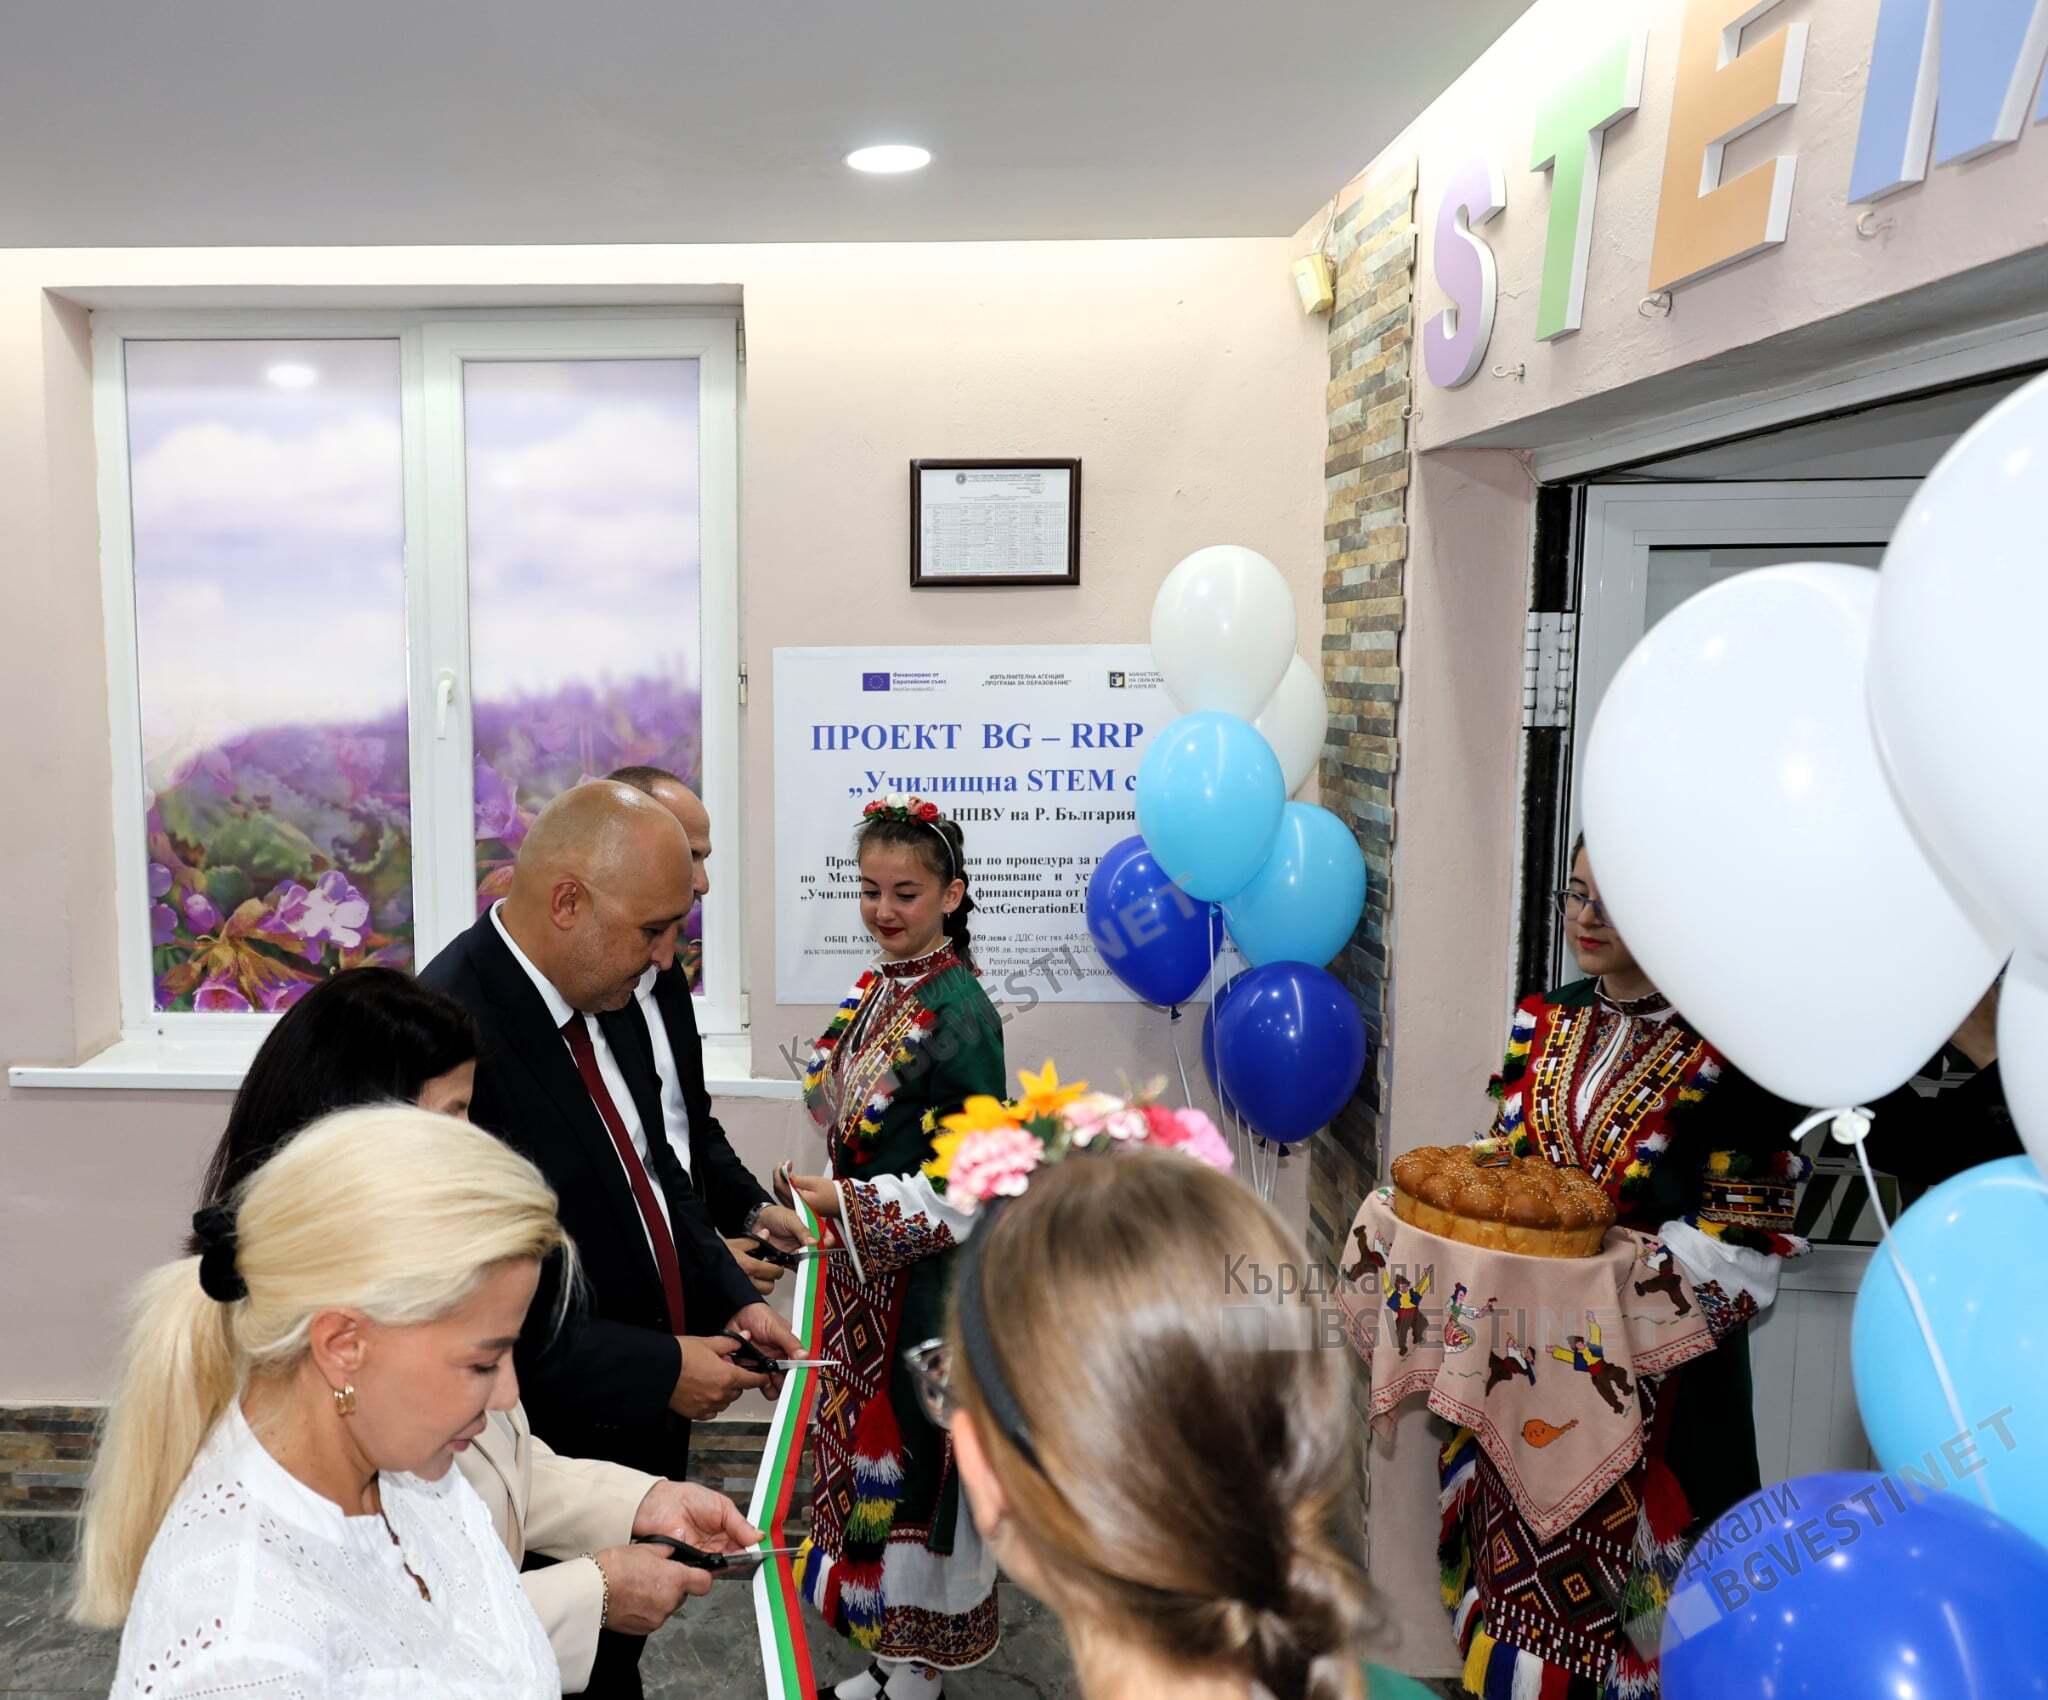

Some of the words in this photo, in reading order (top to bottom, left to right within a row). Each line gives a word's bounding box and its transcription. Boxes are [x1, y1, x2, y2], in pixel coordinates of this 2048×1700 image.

[810, 724, 962, 751] ПРОЕКТ
[981, 723, 1032, 750] BG
[1070, 722, 1144, 749] RRP
[849, 769, 1018, 798] „Училищна
[1027, 768, 1116, 792] STEM
[952, 807, 1005, 822] НПВУ
[1010, 810, 1029, 821] на
[1035, 808, 1050, 821] Р.
[1056, 807, 1136, 824] България
[825, 856, 858, 869] Прое
[986, 857, 1001, 866] по
[1006, 856, 1073, 868] процедура
[1078, 856, 1090, 866] за
[800, 874, 816, 884] по
[828, 872, 861, 883] Меха
[969, 873, 1042, 882] тановяване
[1054, 873, 1062, 881] и
[975, 887, 1062, 901] финансирана
[1065, 889, 1080, 899] от
[824, 935, 847, 944] ОБЩ
